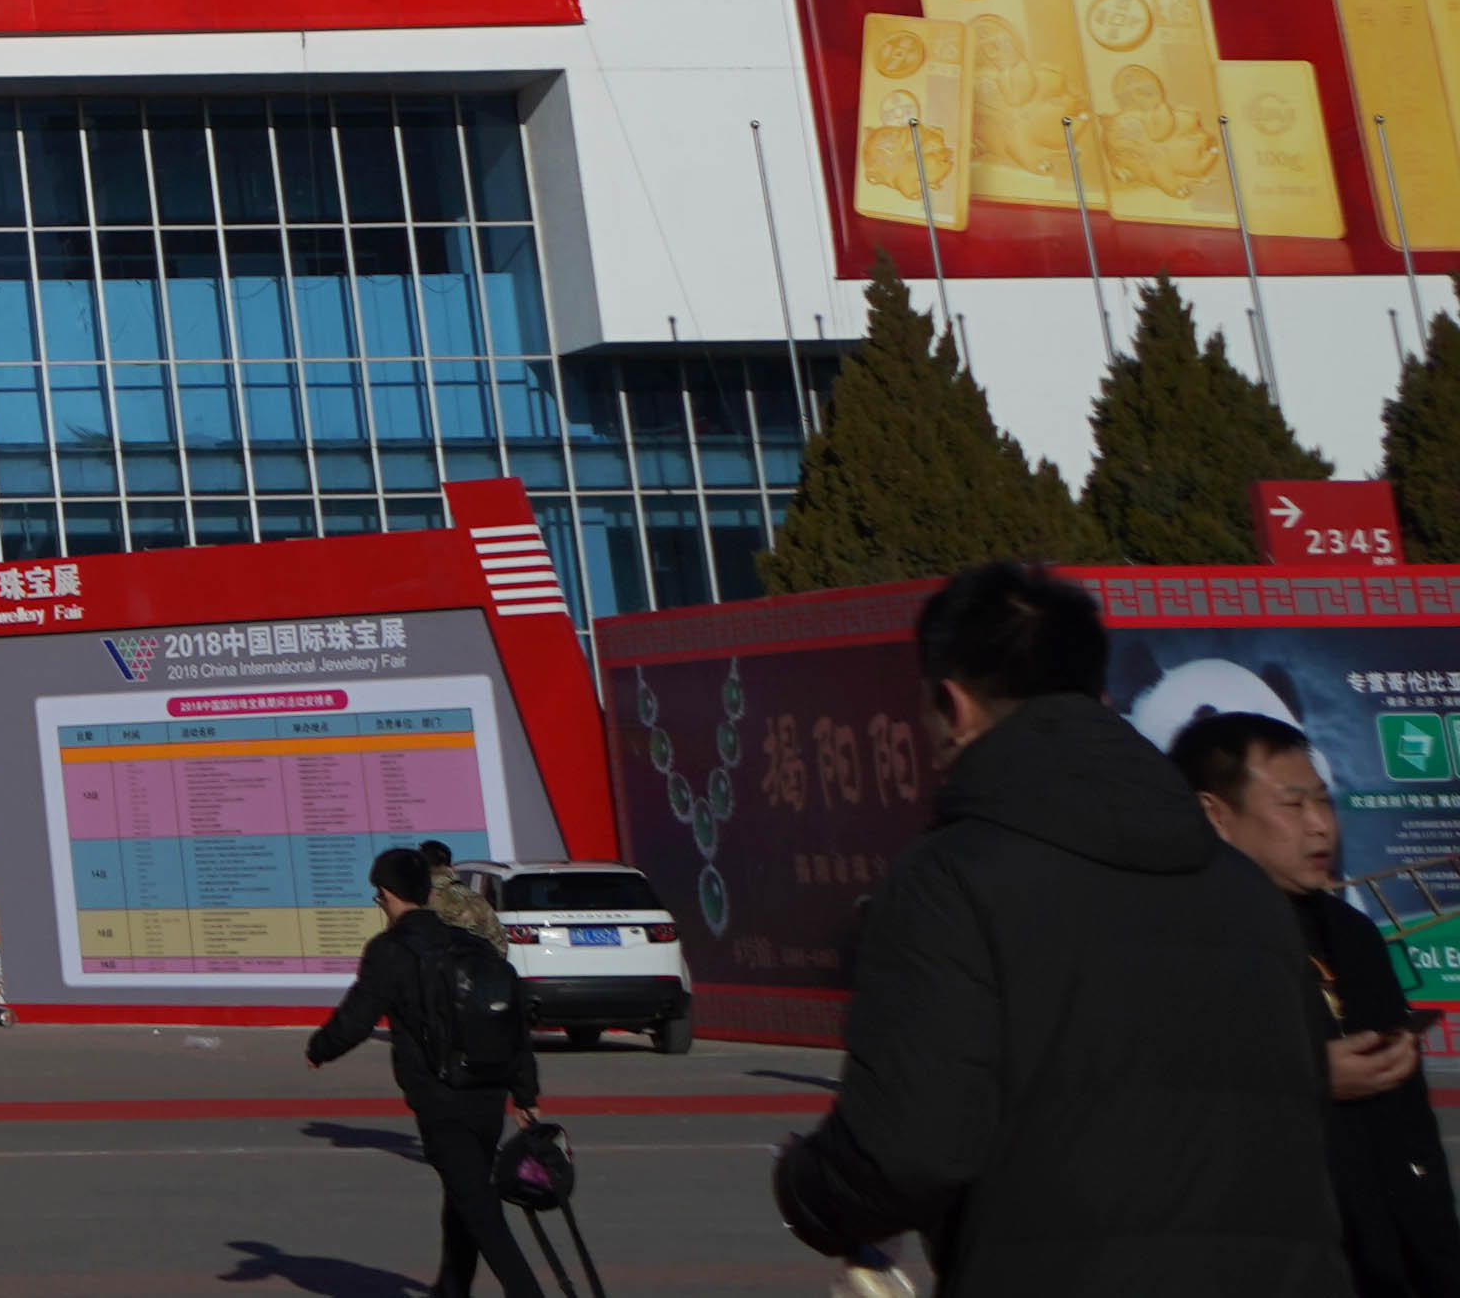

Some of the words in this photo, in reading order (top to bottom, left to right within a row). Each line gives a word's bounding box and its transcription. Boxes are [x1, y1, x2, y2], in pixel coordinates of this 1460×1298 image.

[54, 603, 84, 621] Fair
[200, 661, 237, 679] China
[239, 657, 315, 677] International
[318, 655, 379, 674] Jewellery
[381, 653, 407, 669] Fair
